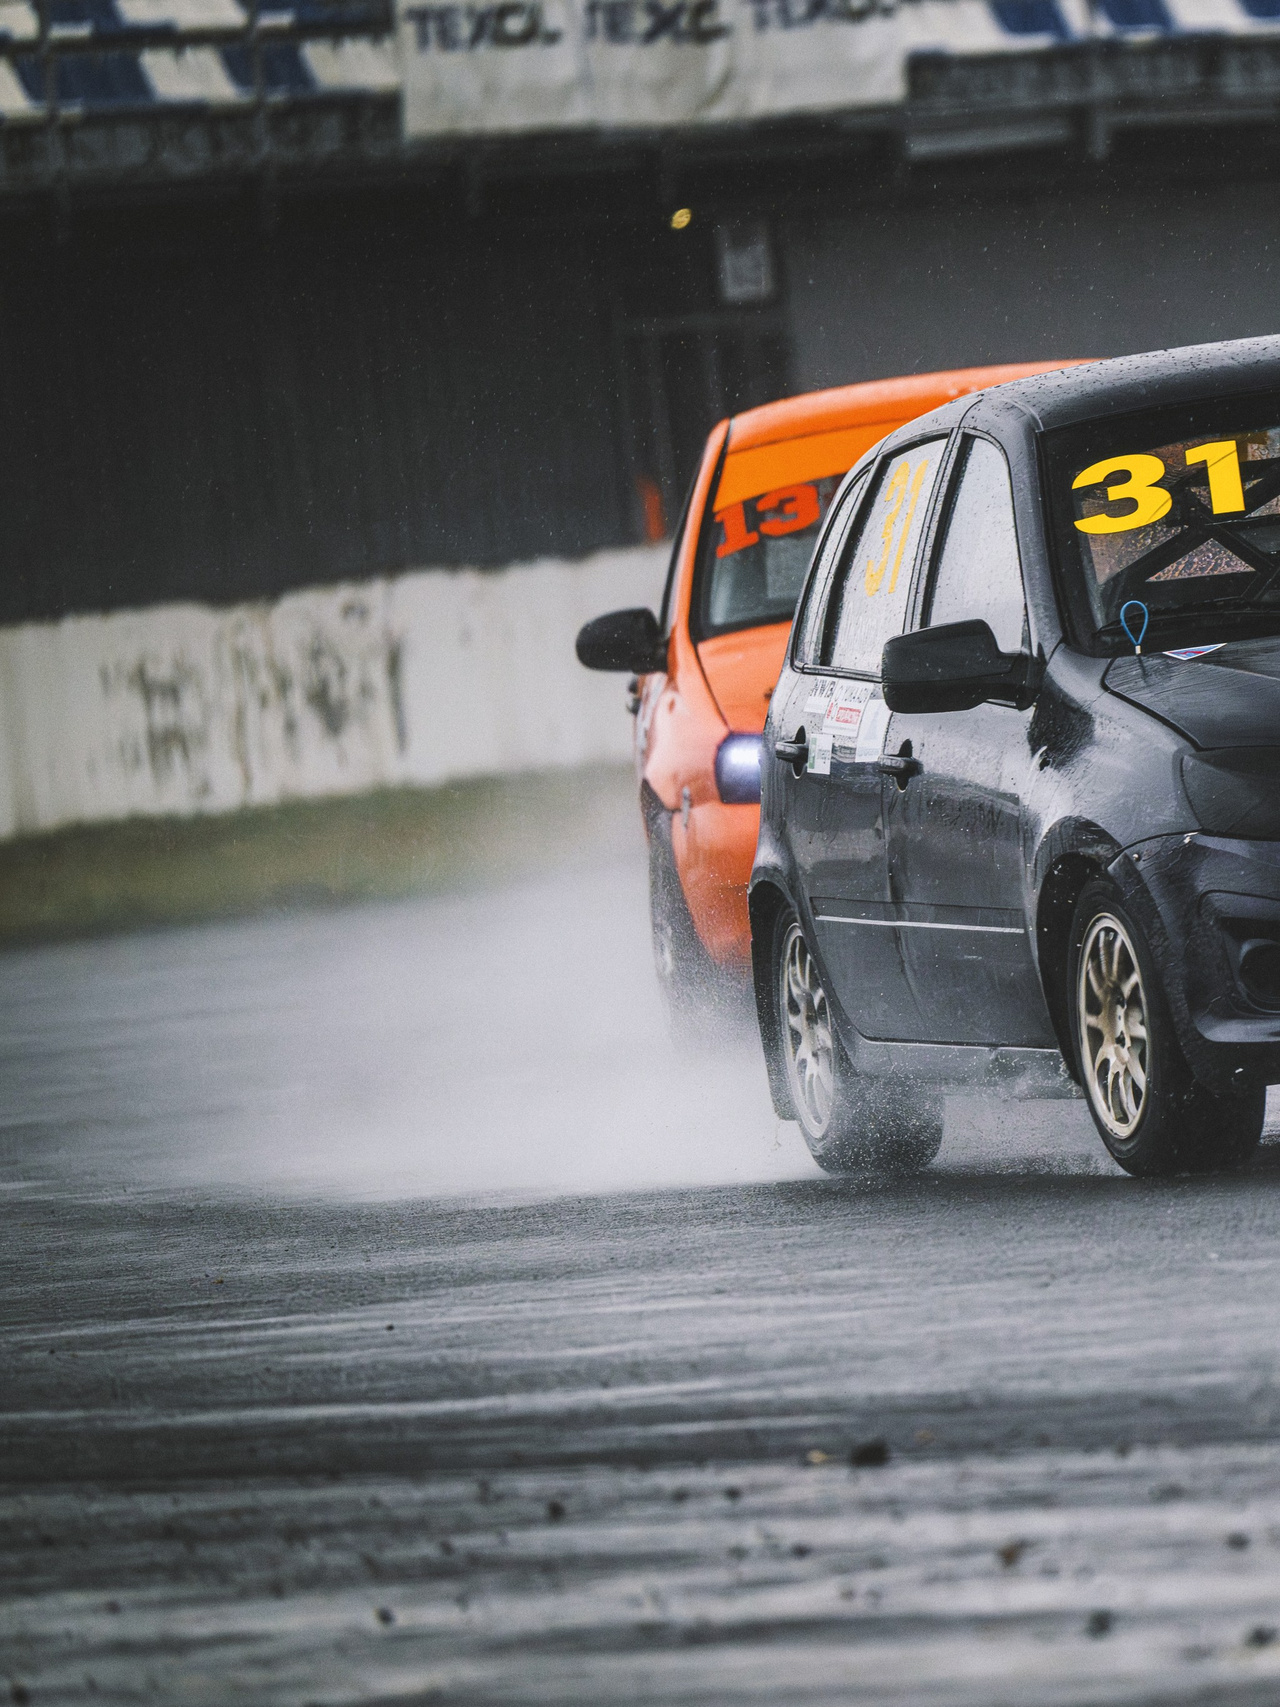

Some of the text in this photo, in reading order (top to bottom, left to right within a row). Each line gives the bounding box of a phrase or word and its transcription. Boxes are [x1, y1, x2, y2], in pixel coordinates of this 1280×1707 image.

[714, 483, 820, 559] 13
[865, 459, 929, 597] 31
[1072, 440, 1246, 534] 31
